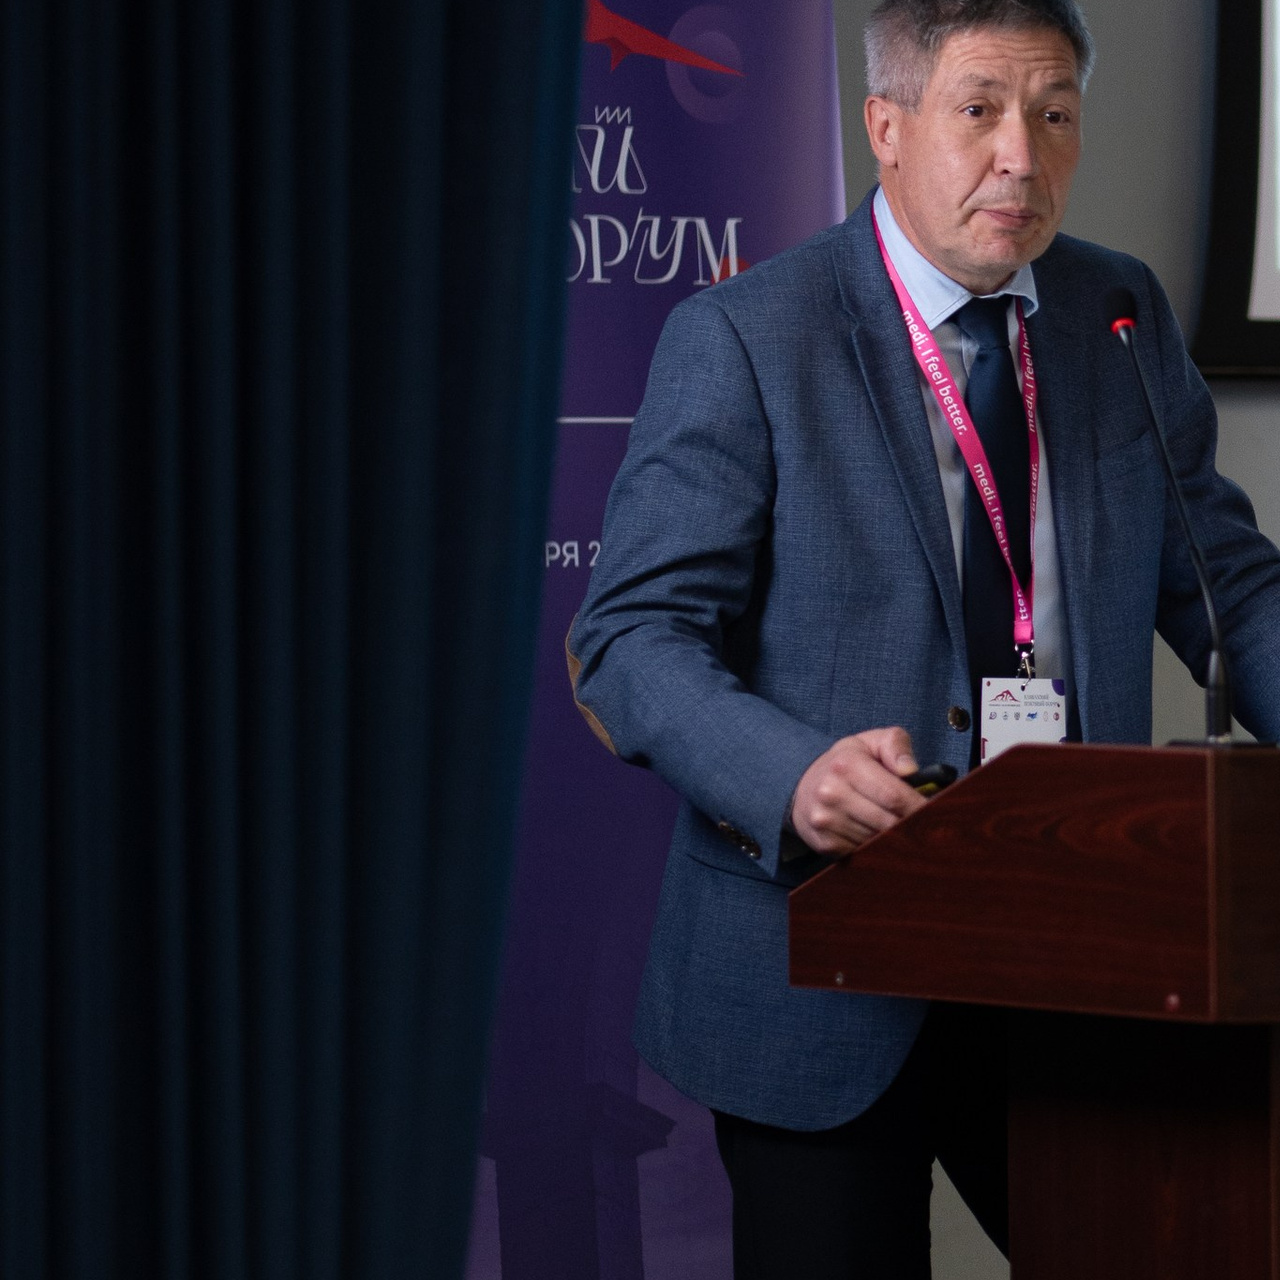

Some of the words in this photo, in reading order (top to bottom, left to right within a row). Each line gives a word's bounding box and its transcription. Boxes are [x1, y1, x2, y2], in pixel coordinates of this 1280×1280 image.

[903, 310, 928, 350] medi.
[925, 356, 948, 385] feel
[938, 384, 969, 436] better.
[1024, 352, 1035, 381] feel
[1024, 392, 1036, 433] medi.
[974, 463, 996, 505] medi.
[993, 515, 1007, 544] feel
